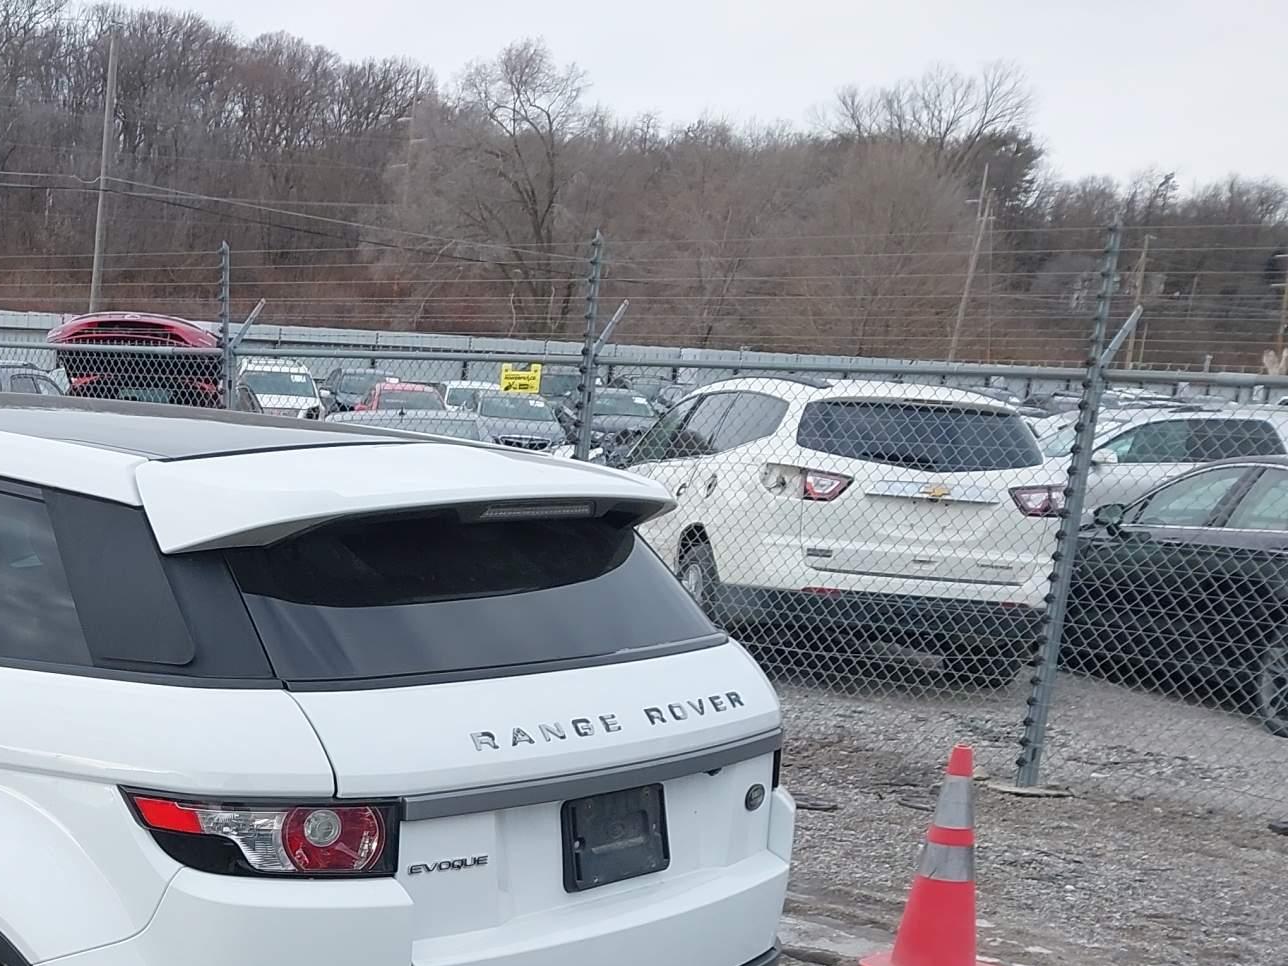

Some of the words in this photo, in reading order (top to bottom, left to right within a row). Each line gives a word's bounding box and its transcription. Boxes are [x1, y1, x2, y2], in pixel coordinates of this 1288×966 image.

[470, 714, 622, 751] RANGE
[643, 691, 745, 726] ROVER
[408, 854, 489, 876] EVOQUE
